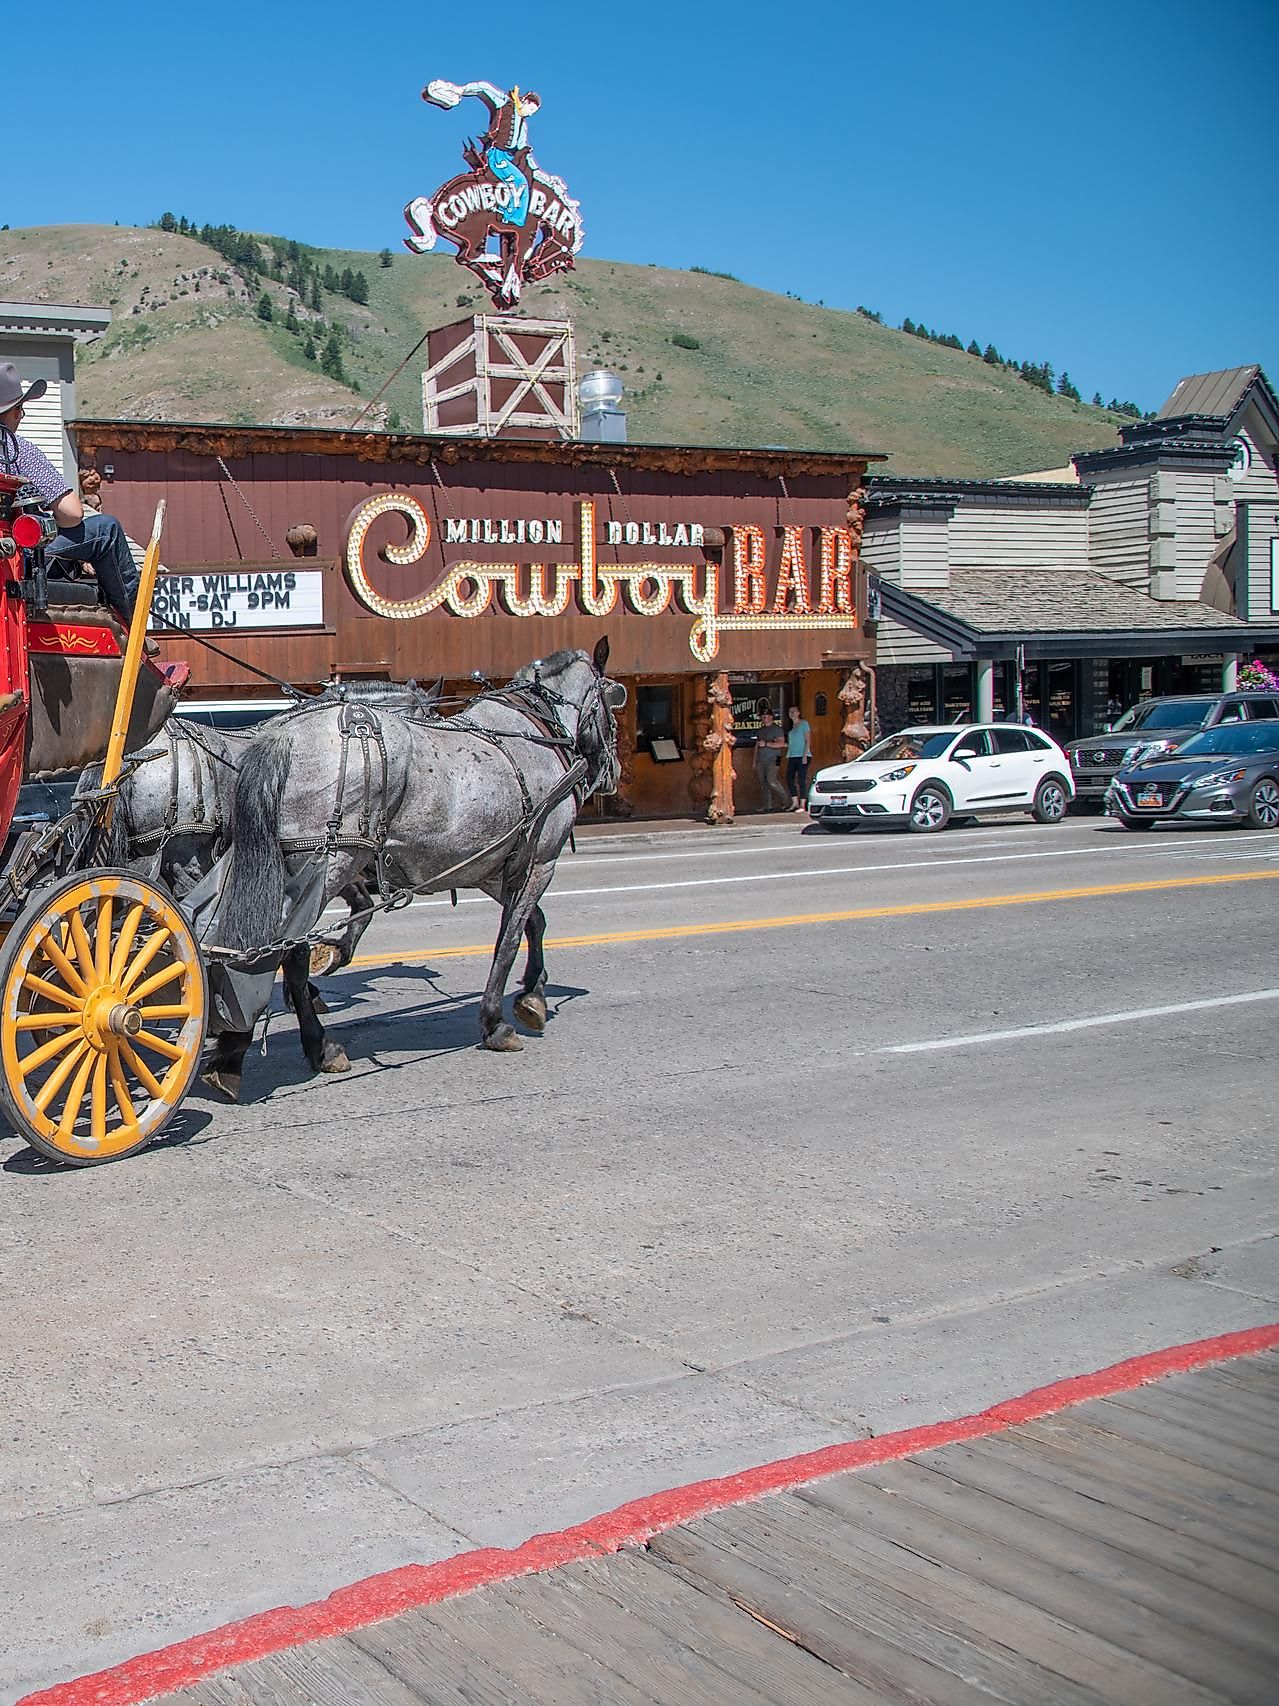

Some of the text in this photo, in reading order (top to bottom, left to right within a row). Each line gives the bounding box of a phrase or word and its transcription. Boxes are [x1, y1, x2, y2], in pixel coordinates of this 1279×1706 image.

[438, 183, 576, 240] COWBOY BAR
[444, 518, 705, 546] MILLION DOLLAR
[154, 573, 296, 595] KER WILLIAMS
[346, 494, 854, 663] Cowboy BAR
[189, 593, 231, 612] -SAT
[247, 591, 290, 610] 9PM
[211, 611, 237, 628] DJ
